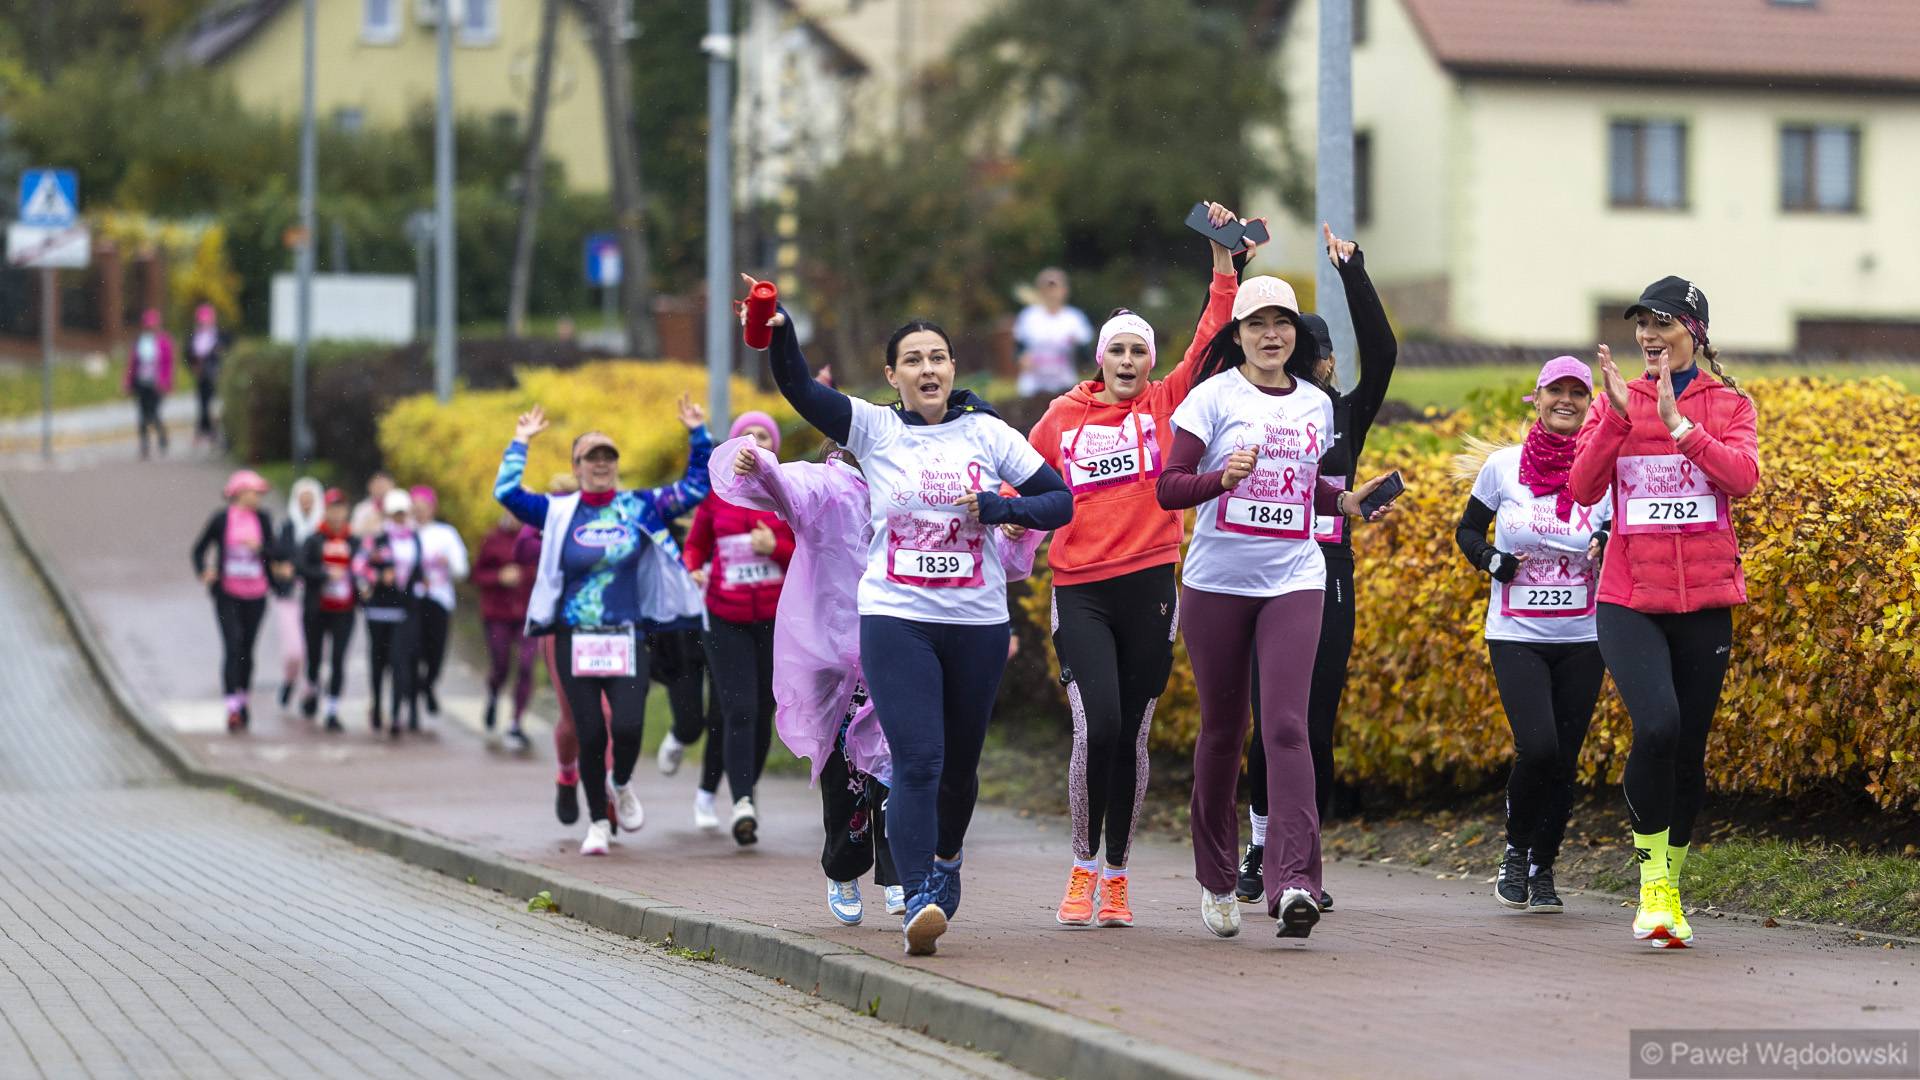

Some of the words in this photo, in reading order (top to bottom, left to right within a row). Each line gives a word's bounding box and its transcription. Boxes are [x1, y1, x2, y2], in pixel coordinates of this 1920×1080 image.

[1265, 434, 1286, 447] Bieg
[1287, 437, 1301, 447] dla
[1261, 443, 1300, 460] Kobiet
[1087, 454, 1134, 478] 2895
[1644, 463, 1677, 475] Różowy
[920, 480, 945, 493] Bieg
[947, 481, 962, 491] dla
[1250, 477, 1268, 488] Bieg
[1268, 479, 1279, 487] dla
[1645, 480, 1679, 496] Kobiet
[918, 490, 962, 507] Kobie
[1248, 485, 1279, 498] Kobiet
[1248, 505, 1293, 525] 1849
[1648, 501, 1699, 520] 2782
[1529, 521, 1571, 536] Kobiet
[916, 556, 960, 573] 1839
[1528, 590, 1573, 606] 2232
